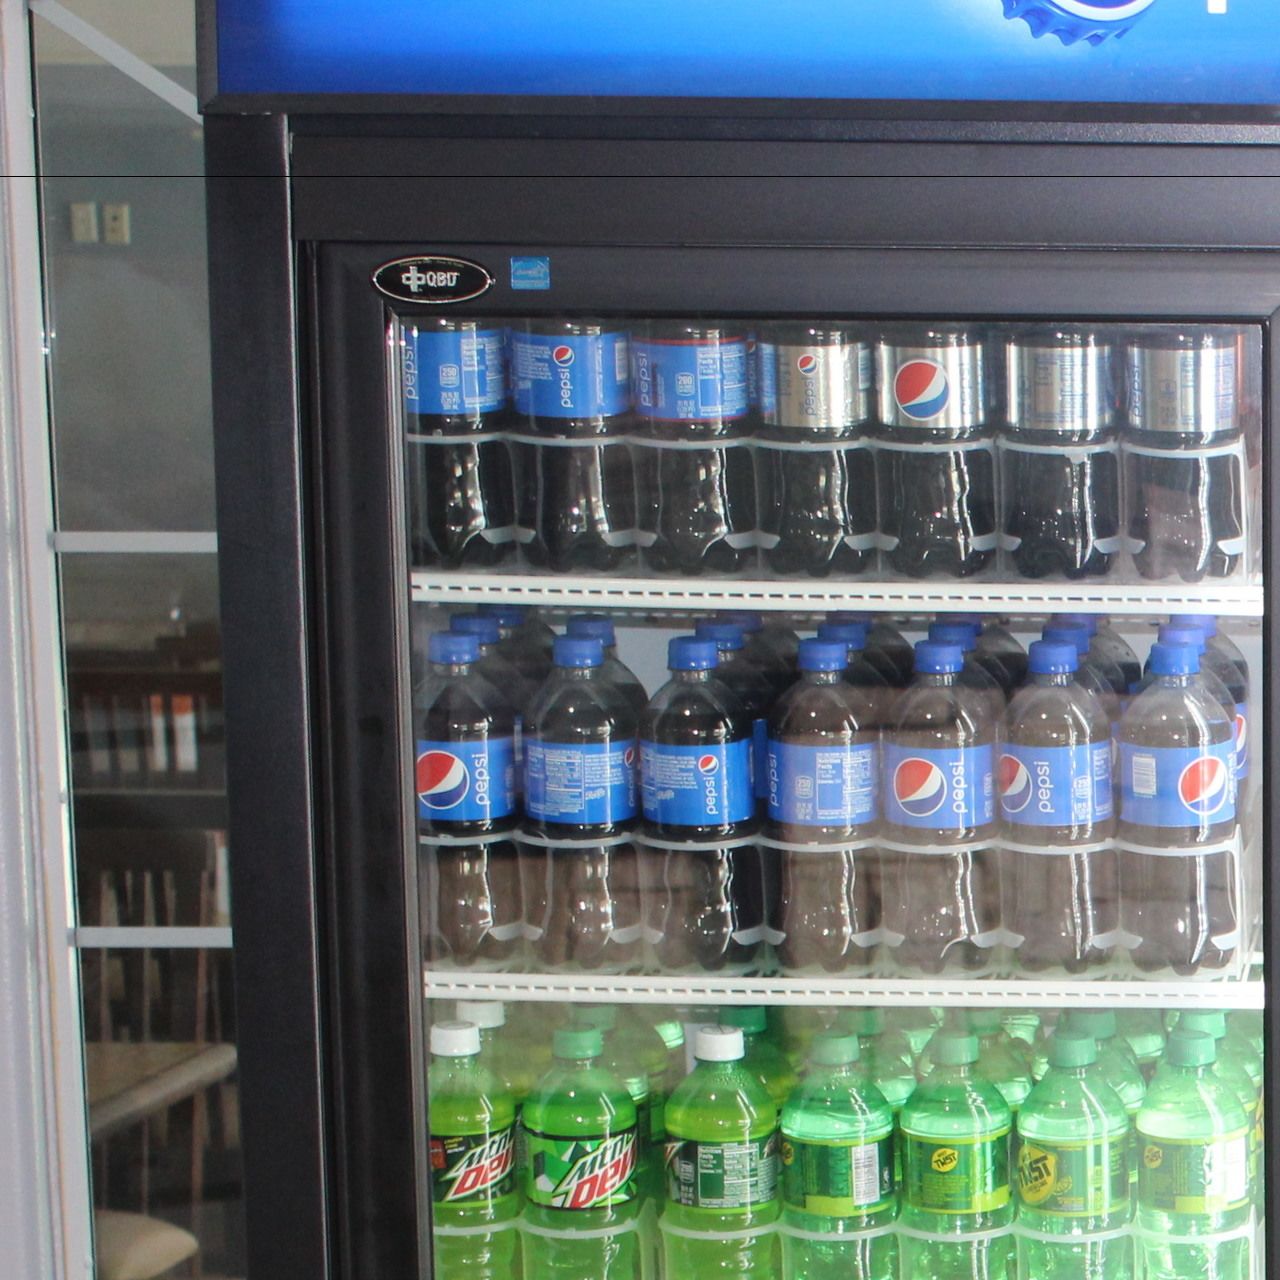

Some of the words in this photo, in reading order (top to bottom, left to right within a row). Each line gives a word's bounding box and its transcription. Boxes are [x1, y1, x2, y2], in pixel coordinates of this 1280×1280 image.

[559, 368, 574, 409] pepsi
[640, 351, 653, 407] pepsi
[472, 752, 489, 807] pepsi
[705, 776, 720, 816] pepsi
[769, 753, 779, 807] pepsi
[950, 757, 969, 814] pepsi
[1034, 760, 1056, 814] pepsi
